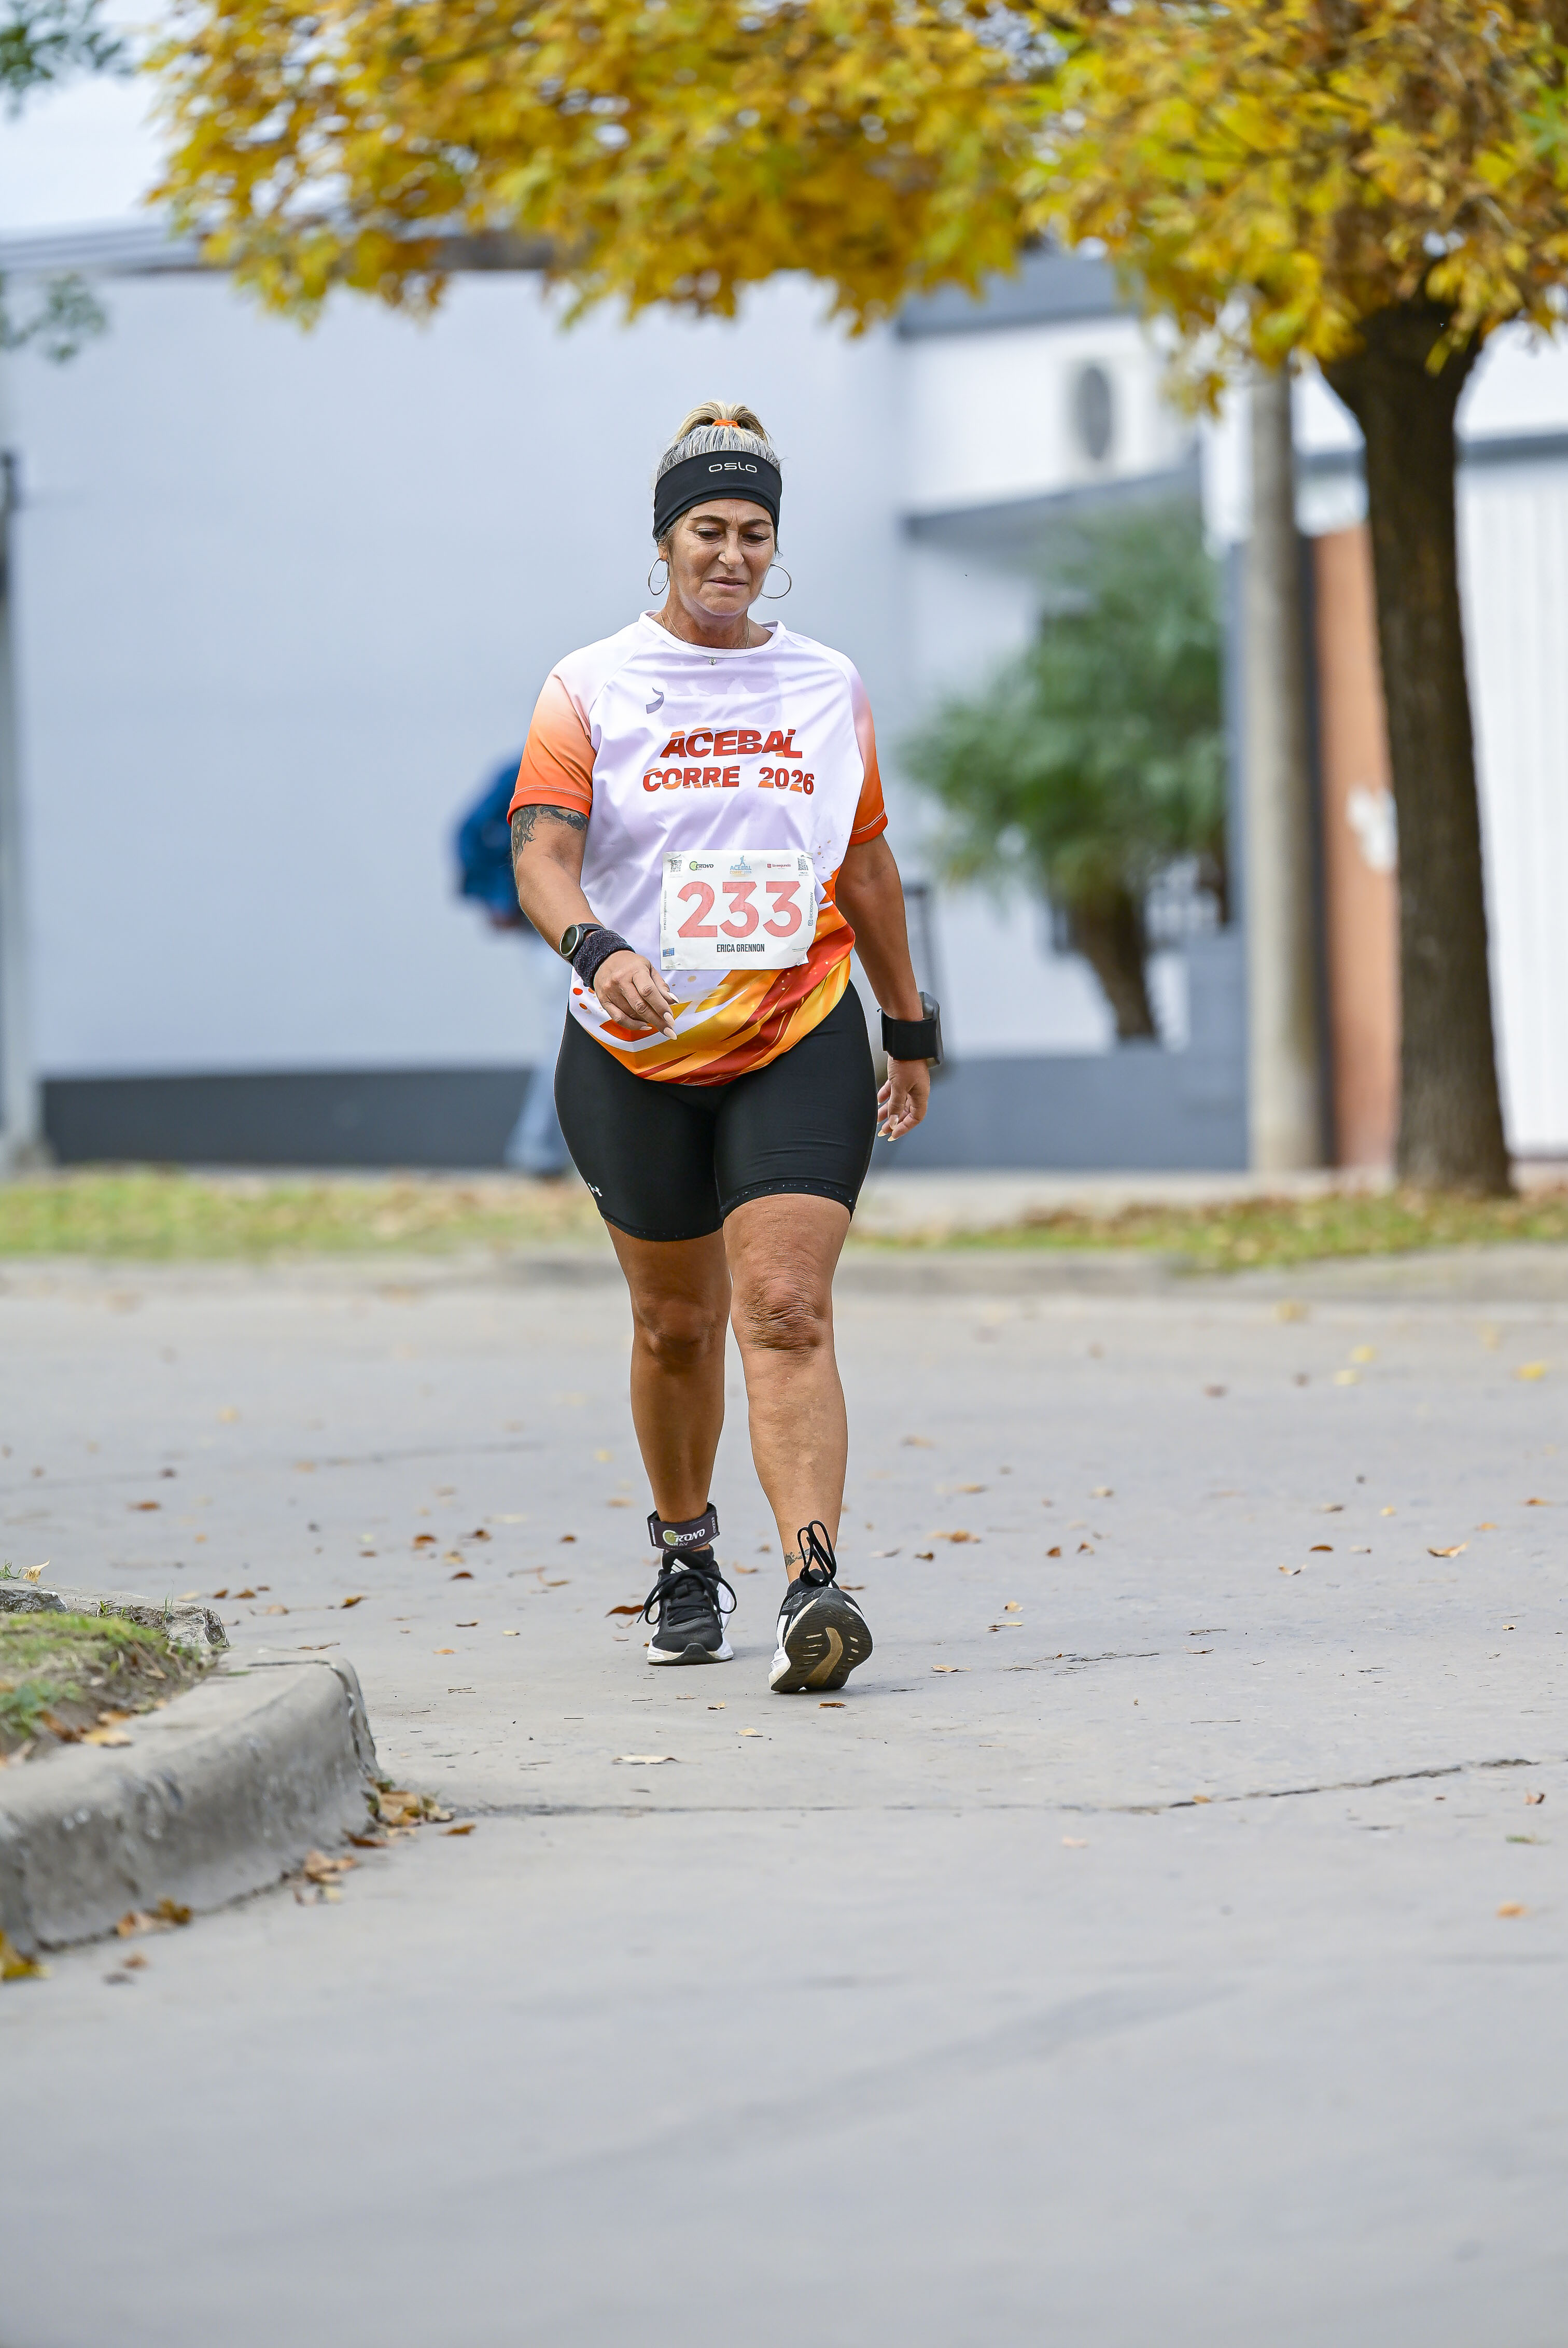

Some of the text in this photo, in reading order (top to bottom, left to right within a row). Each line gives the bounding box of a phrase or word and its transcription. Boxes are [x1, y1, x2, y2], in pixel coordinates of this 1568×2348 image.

[660, 728, 803, 758] ACEBAL
[643, 765, 815, 795] CORRE 2026
[677, 881, 802, 938] 233
[717, 943, 765, 953] ERICA GRENNON
